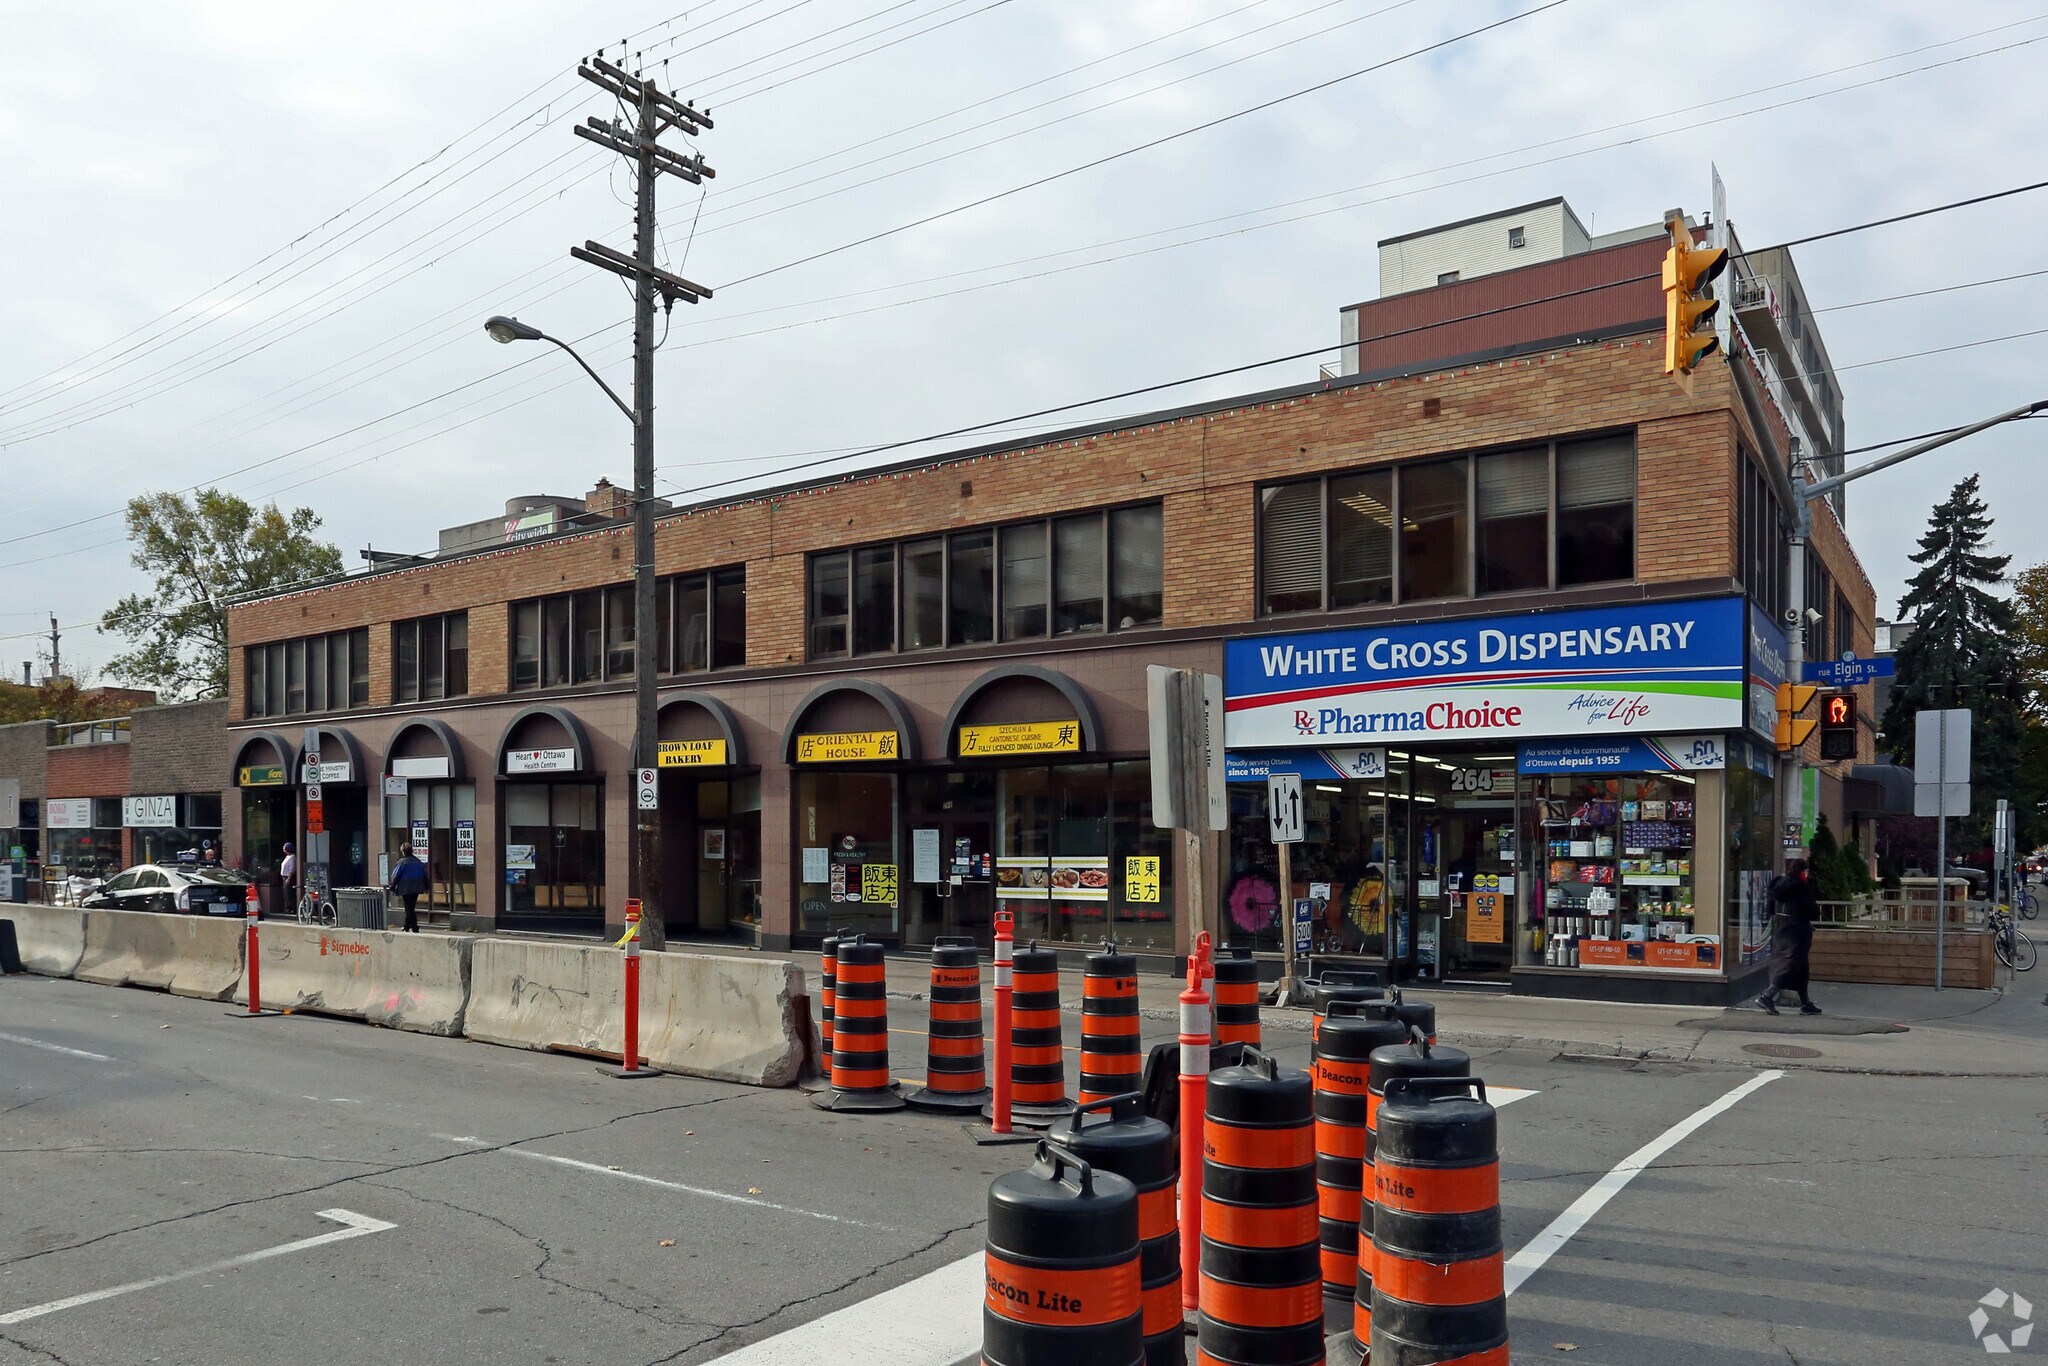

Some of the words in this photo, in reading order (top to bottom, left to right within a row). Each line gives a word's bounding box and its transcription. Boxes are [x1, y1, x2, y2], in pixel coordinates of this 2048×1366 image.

[1260, 644, 1357, 677] WHITE
[1366, 637, 1468, 670] CROSS
[1479, 620, 1695, 664] DISPENSARY
[1818, 668, 1831, 676] rue
[1834, 662, 1862, 678] Elgin
[1866, 664, 1878, 673] St.
[1567, 693, 1616, 712] Advice
[1587, 708, 1607, 725] for
[1607, 694, 1651, 726] Life
[1317, 700, 1522, 735] PharmaChoice
[999, 726, 1027, 734] SZECHUAN
[1054, 724, 1076, 747] 東
[816, 734, 876, 746] ORIENTAL
[878, 734, 896, 755] 飯
[962, 730, 980, 752] 方
[989, 735, 1020, 743] CANTONESE
[658, 743, 688, 752] BROWN
[690, 741, 714, 751] LOAF
[800, 738, 815, 758] 店
[978, 745, 991, 753] FULLY
[1537, 748, 1561, 756] service
[1562, 747, 1572, 755] de
[1573, 747, 1580, 755] la
[1581, 746, 1630, 755] communauté
[515, 753, 532, 761] Heart
[543, 751, 566, 760] Ottawa
[826, 748, 867, 758] HOUSE
[665, 754, 703, 764] BAKERY
[1226, 759, 1248, 768] Proudly
[1249, 759, 1270, 767] serving
[1525, 758, 1558, 767] d'Ottawa
[1559, 757, 1594, 767] depuis
[1596, 756, 1620, 765] 1955
[524, 762, 540, 770] Health
[540, 761, 557, 769] Centre
[1228, 768, 1249, 776] since
[1250, 767, 1270, 775] 1955
[1451, 768, 1493, 791] 264
[134, 798, 173, 818] GINZA
[415, 829, 425, 838] FOR
[460, 830, 471, 839] FOR
[412, 839, 428, 848] LEASE
[457, 840, 474, 849] LEASE
[803, 901, 827, 911] OPEN
[331, 940, 370, 955] Signebec
[943, 975, 970, 983] Beacon
[1322, 1067, 1363, 1085] Beacon
[1385, 1177, 1415, 1198] Lite
[985, 1274, 1030, 1305] eacon
[1036, 1289, 1083, 1314] Lite
